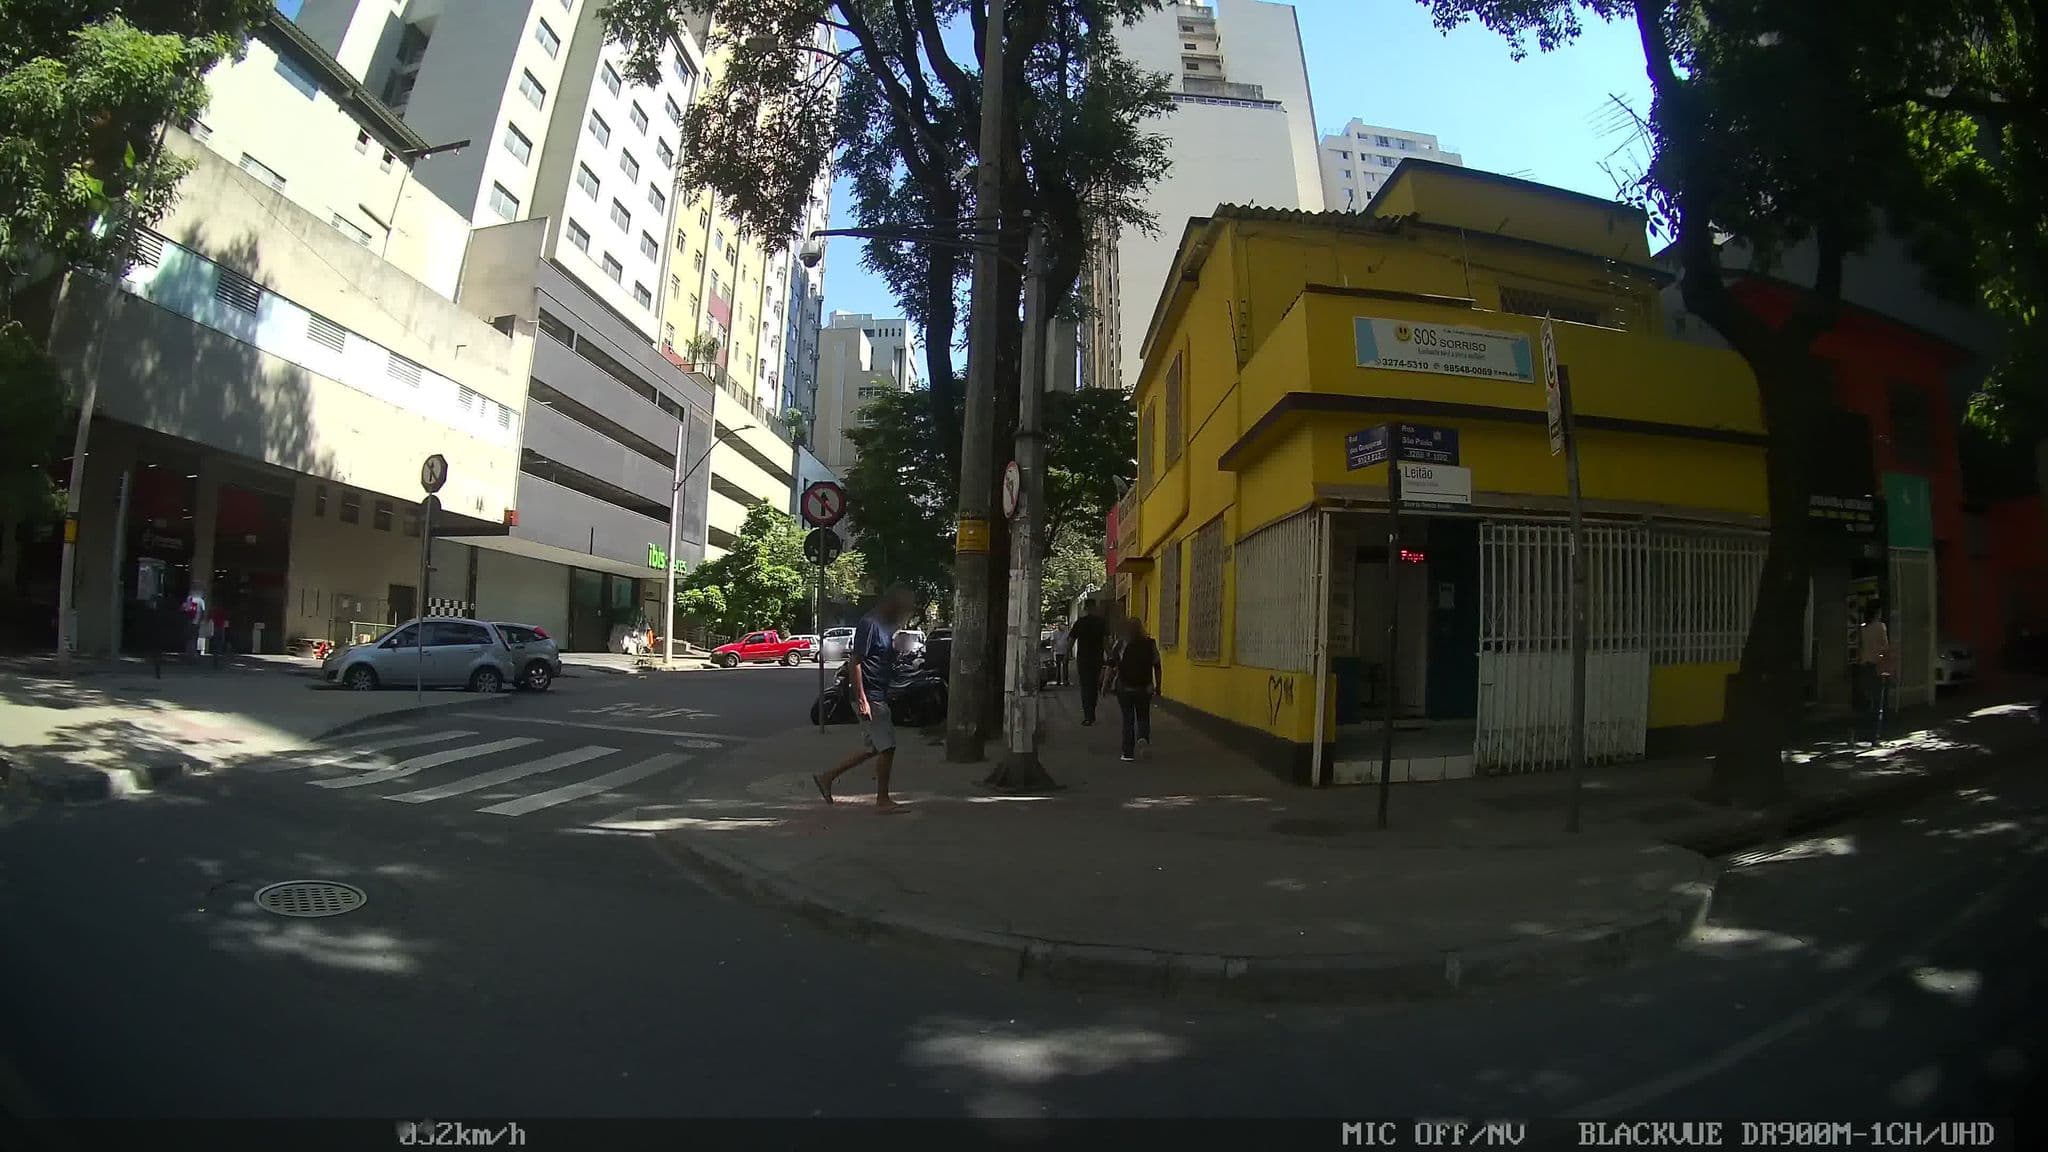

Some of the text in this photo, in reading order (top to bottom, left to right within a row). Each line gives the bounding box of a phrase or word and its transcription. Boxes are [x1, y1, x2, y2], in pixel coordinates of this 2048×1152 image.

[1413, 328, 1437, 346] SOS
[1440, 339, 1486, 352] SORRISO
[1382, 358, 1429, 370] 3274-5310
[1405, 466, 1433, 480] Leitão
[648, 543, 666, 569] ibis
